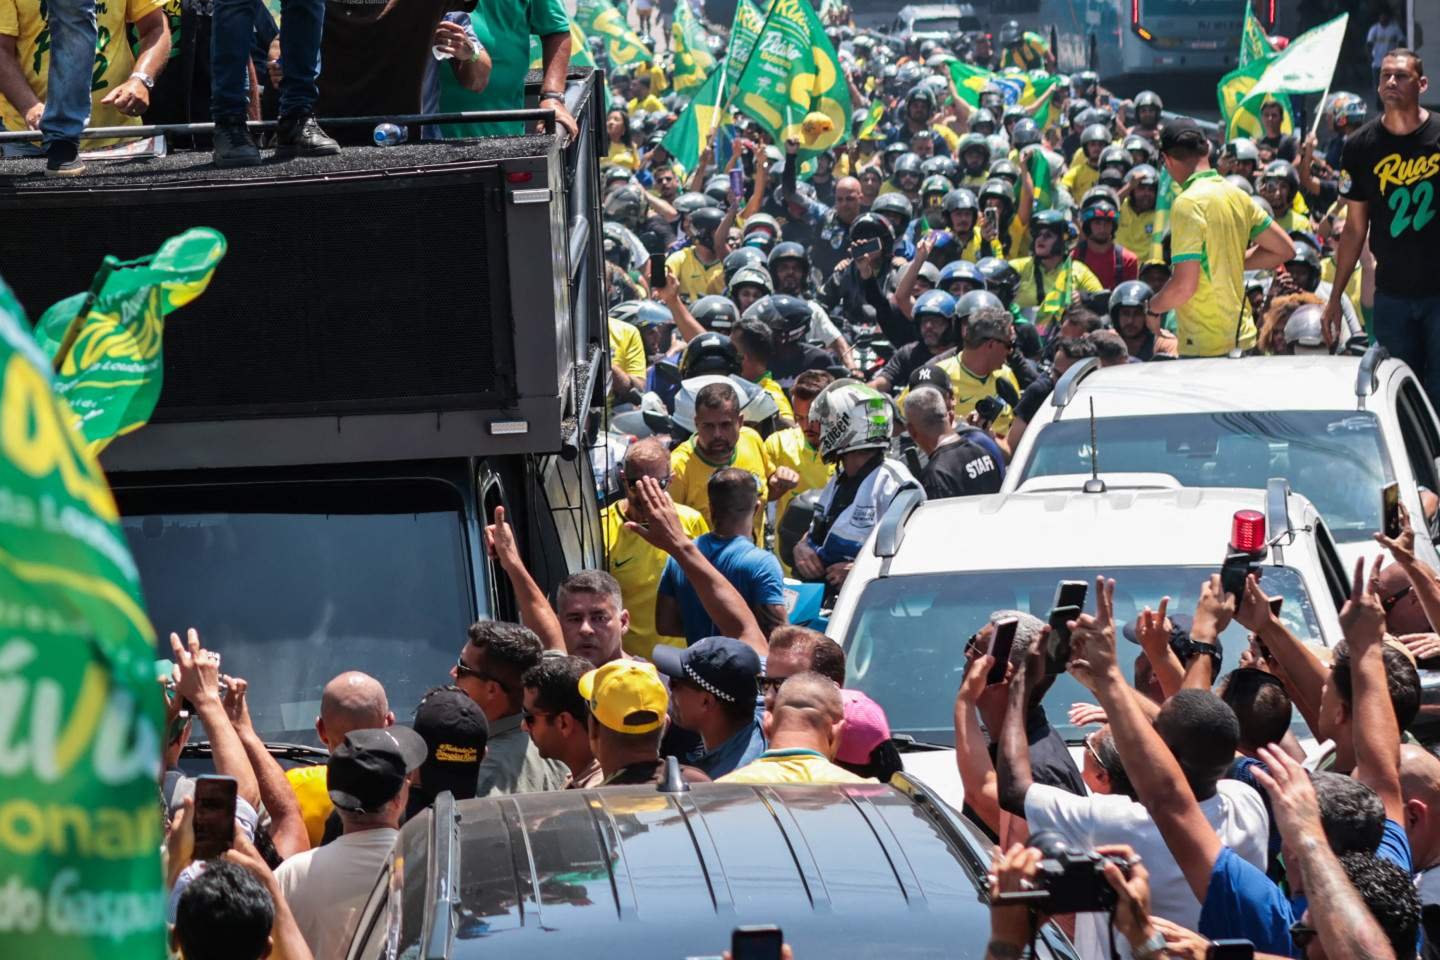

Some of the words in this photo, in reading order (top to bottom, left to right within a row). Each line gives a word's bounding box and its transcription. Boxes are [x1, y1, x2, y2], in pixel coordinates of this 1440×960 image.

[1372, 152, 1440, 197] Ruas
[1387, 180, 1438, 239] 22
[918, 368, 932, 381] NY
